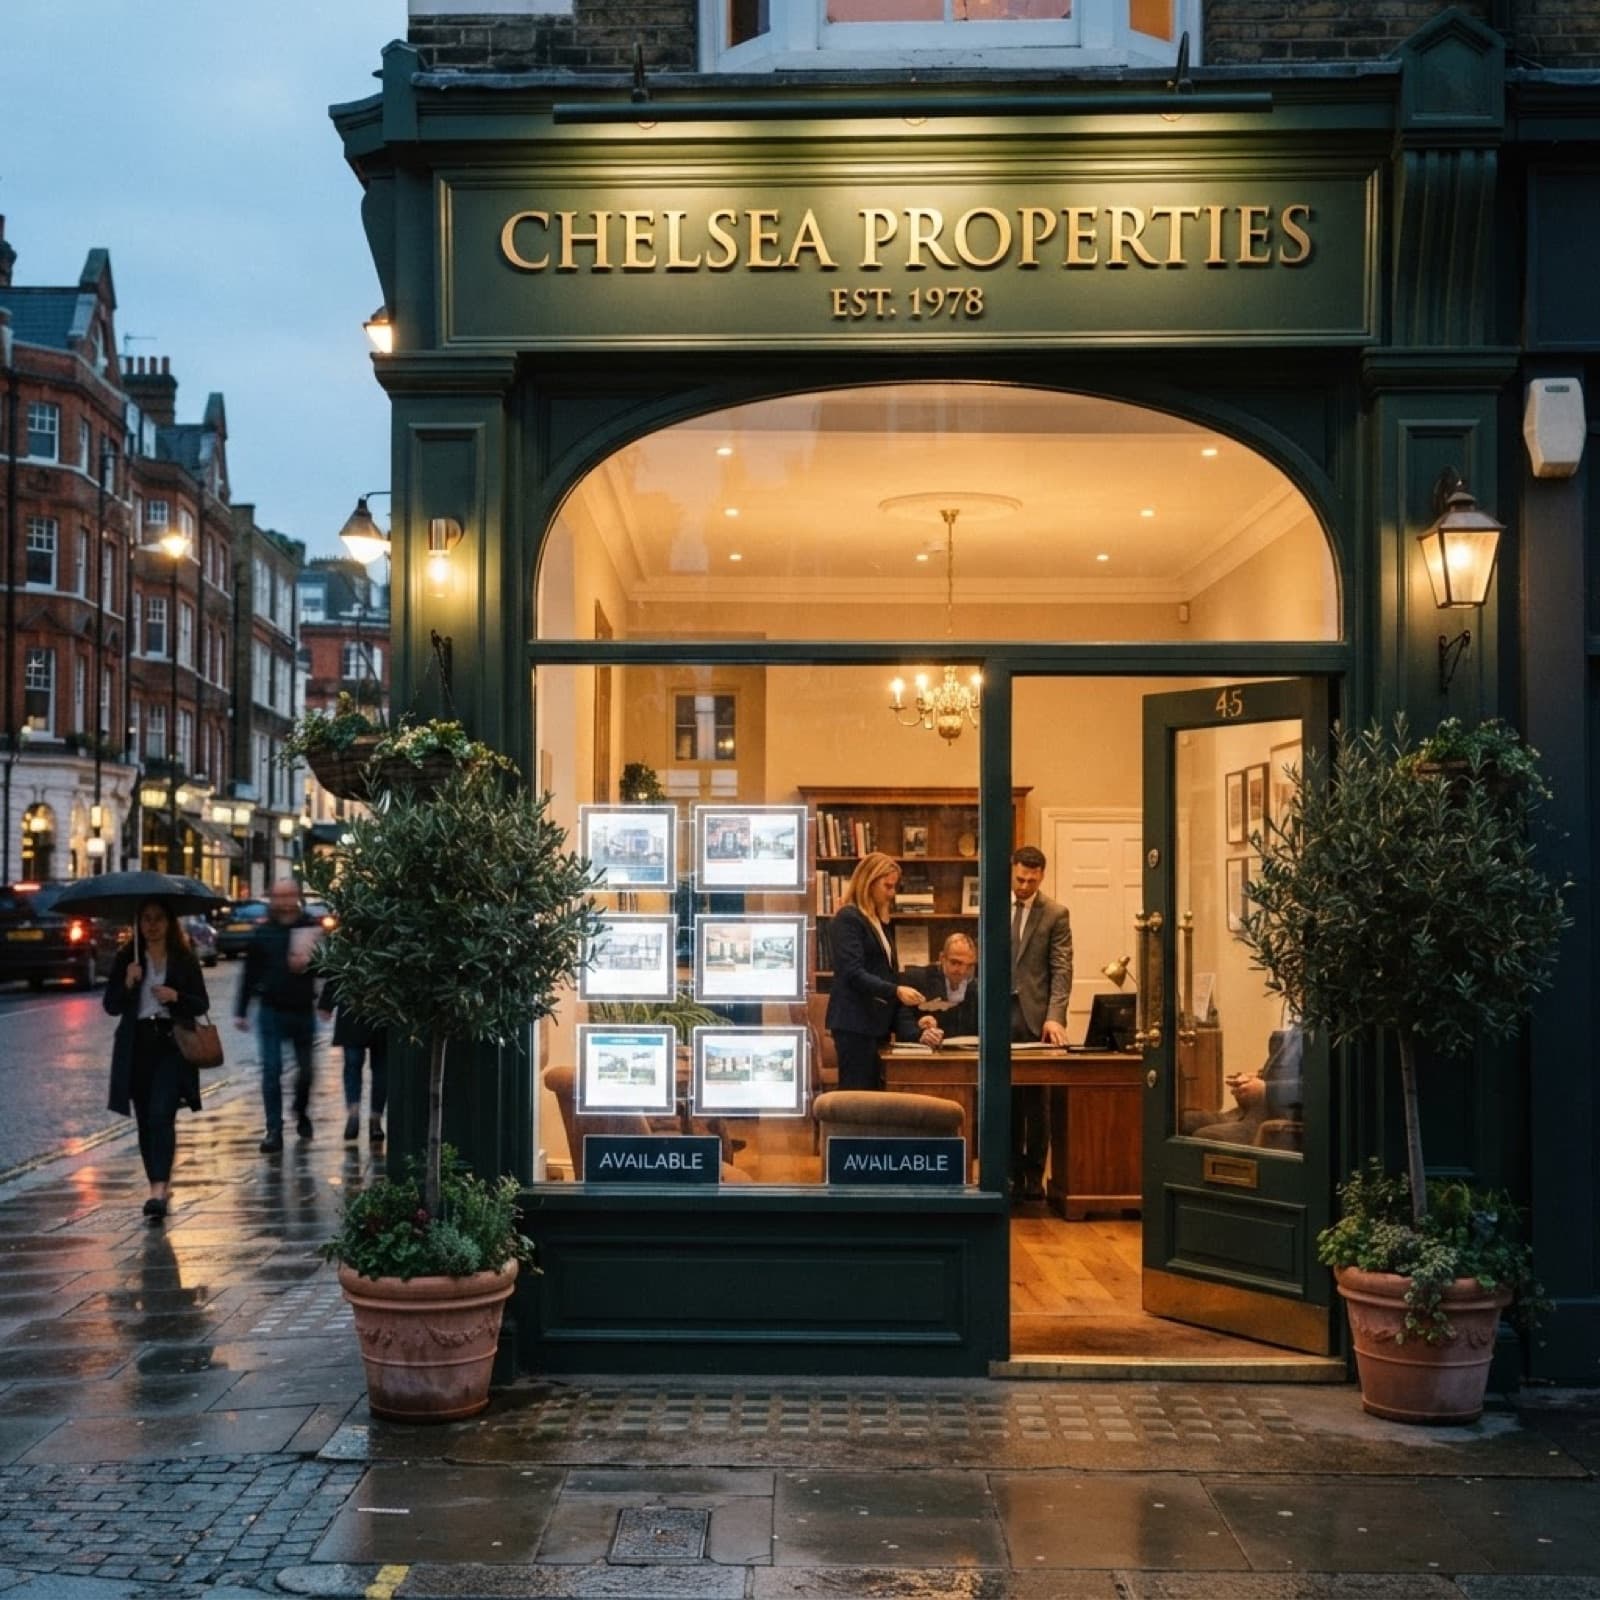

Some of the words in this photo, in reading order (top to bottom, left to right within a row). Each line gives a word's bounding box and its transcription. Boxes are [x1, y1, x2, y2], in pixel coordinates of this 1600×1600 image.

[500, 208, 840, 271] CHELSEA
[858, 204, 1312, 268] PROPERTIES
[830, 288, 897, 317] EST.
[908, 286, 984, 318] 1978
[1215, 689, 1243, 718] 45
[599, 1152, 704, 1171] AVAILABLE
[843, 1154, 950, 1173] AVAILABLE
